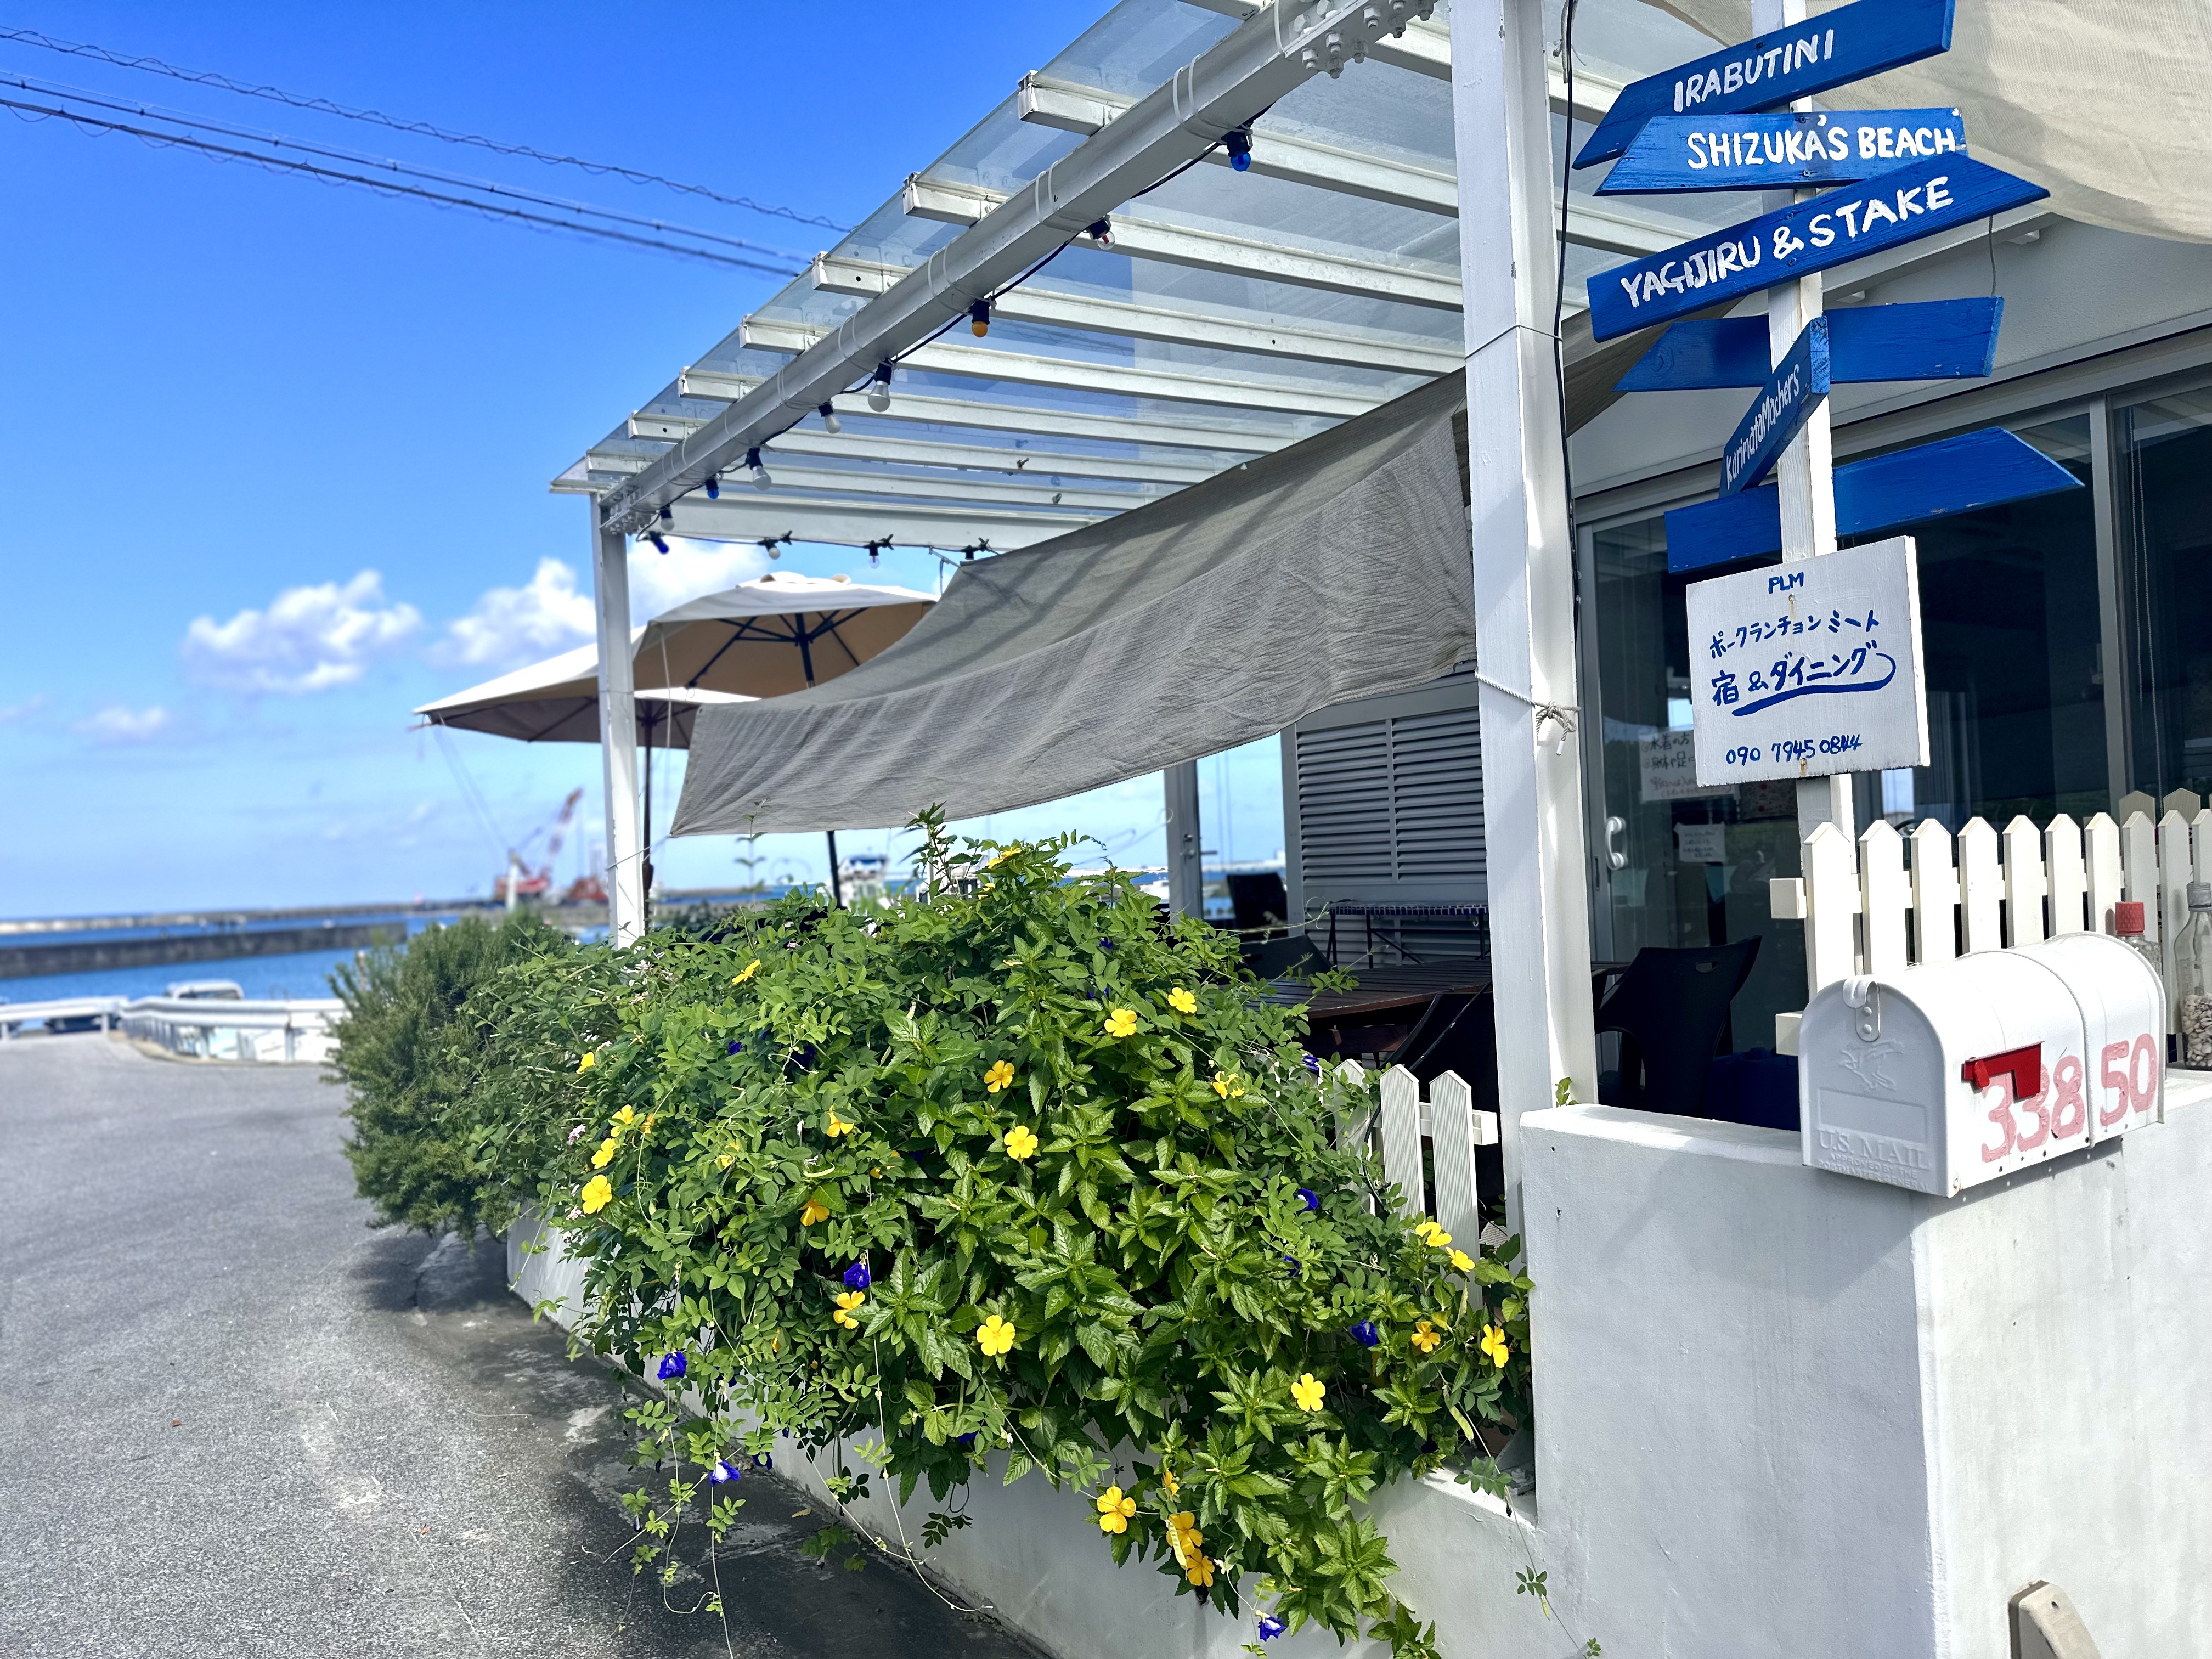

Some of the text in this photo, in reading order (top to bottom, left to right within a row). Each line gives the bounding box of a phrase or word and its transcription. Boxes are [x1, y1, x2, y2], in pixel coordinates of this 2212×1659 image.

[1673, 29, 1834, 112] IRABUTINI
[1688, 115, 1955, 171] SHIZUKA'S BEACH
[1621, 176, 1954, 309] YAGIJIRU & STAKE
[1768, 571, 1804, 594] PLM
[1725, 746, 1760, 766] 090
[1771, 740, 1816, 763] 7945
[2100, 1033, 2159, 1126] 50
[1831, 1153, 1918, 1179] APPROVED BY THE
